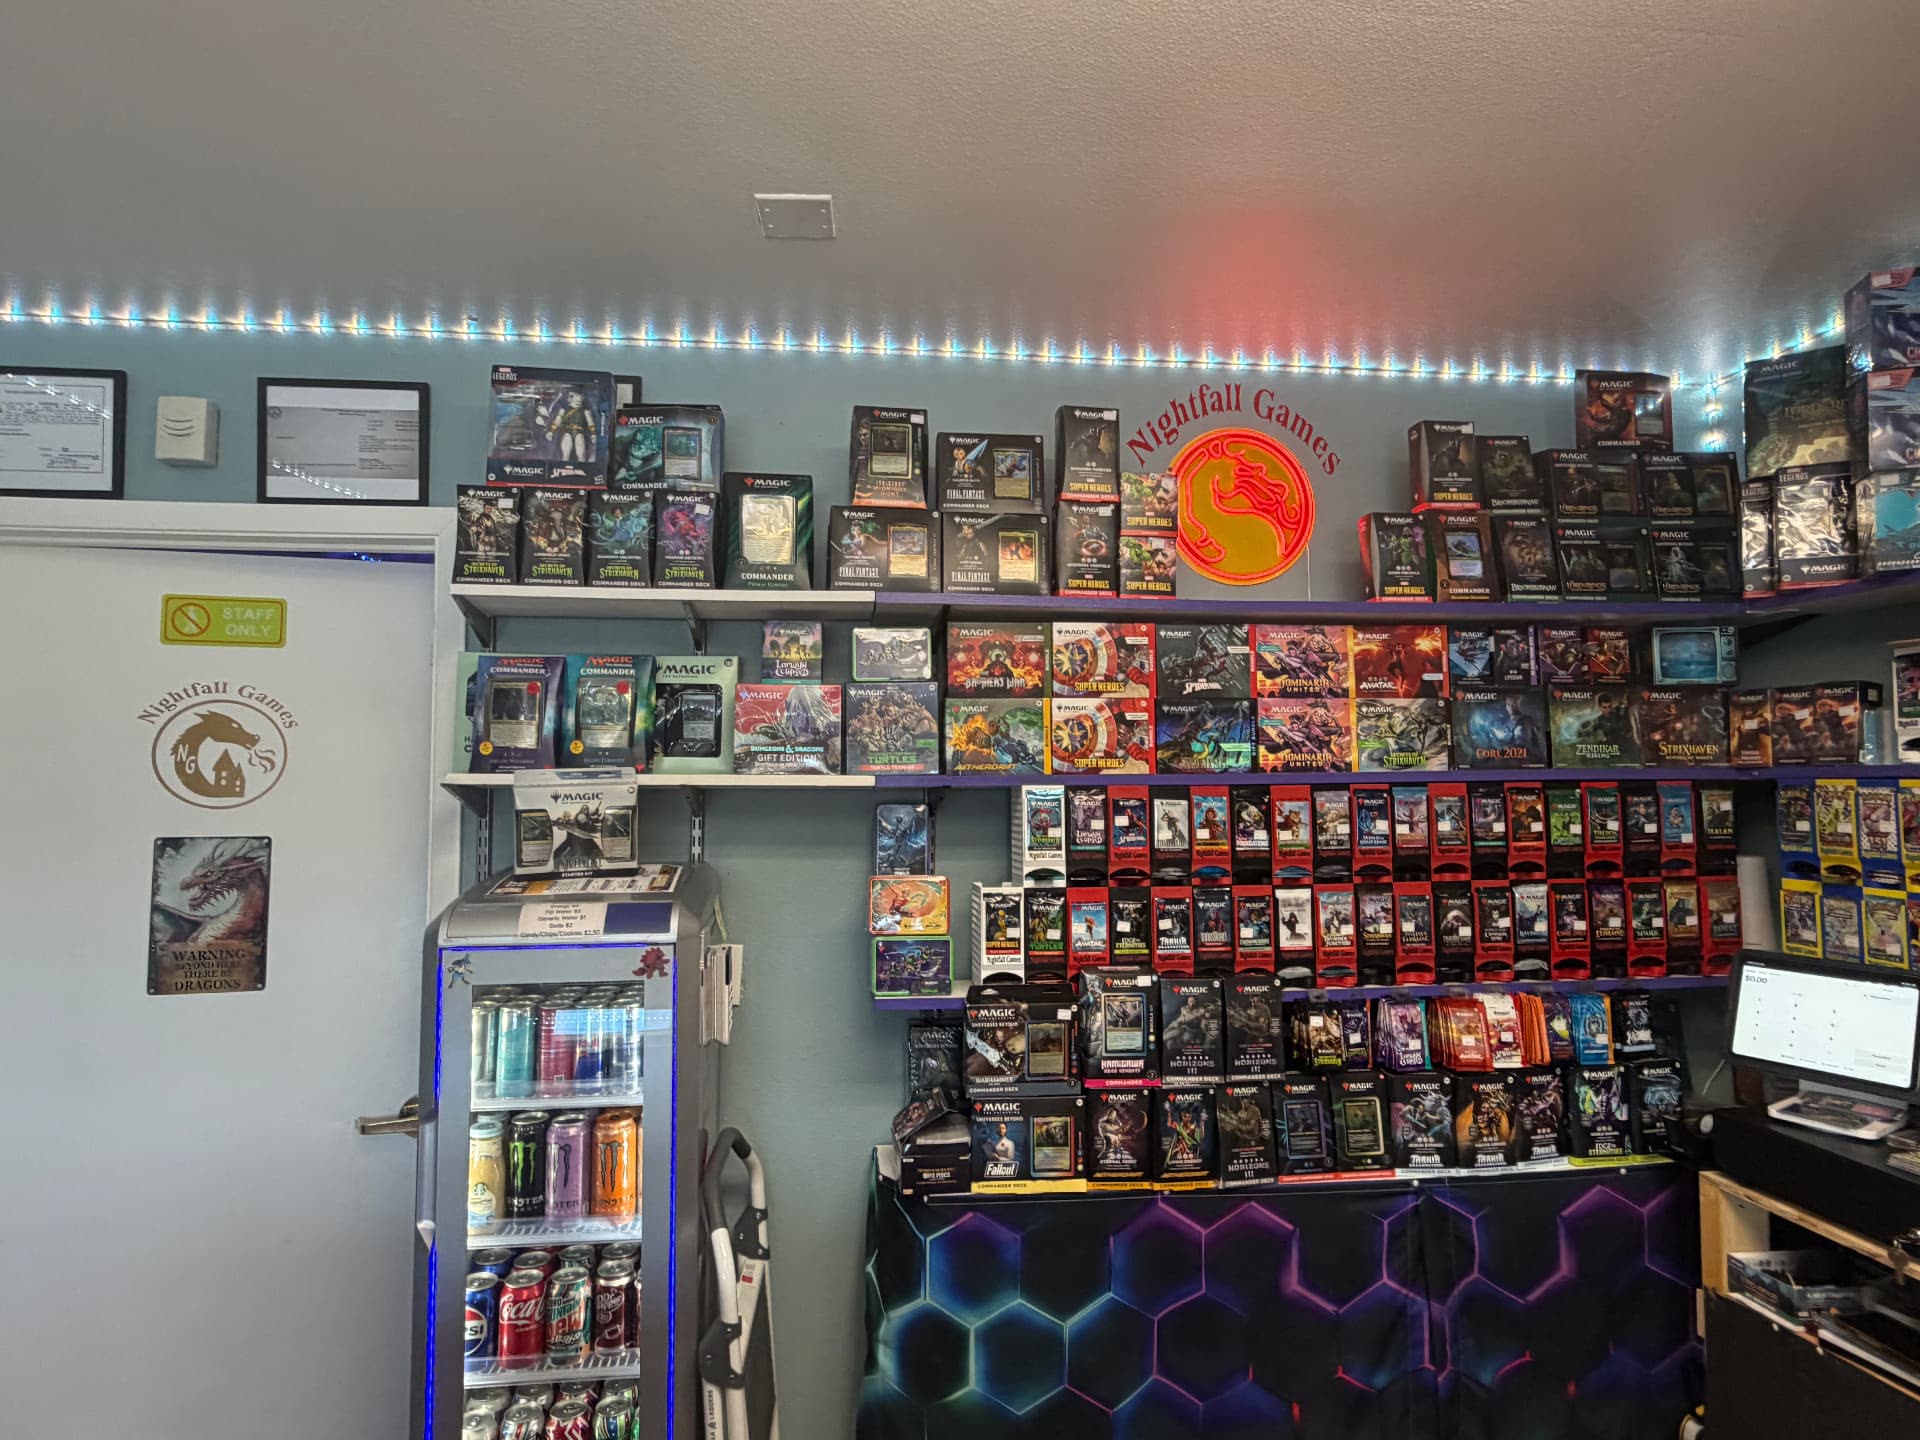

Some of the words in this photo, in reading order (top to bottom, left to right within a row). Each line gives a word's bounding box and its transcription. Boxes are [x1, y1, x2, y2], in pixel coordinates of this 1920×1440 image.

[628, 416, 663, 425] MAGIC
[1126, 383, 1241, 468] Nightfall
[1254, 388, 1341, 476] Games
[512, 466, 543, 475] MAGIC
[1779, 471, 1809, 482] LEGENDS
[475, 490, 506, 498] MAGIC
[542, 491, 573, 499] MAGIC
[608, 494, 639, 502] MAGIC
[1127, 517, 1149, 526] SUPER
[1150, 517, 1173, 527] HEROES
[1810, 563, 1848, 572] MAGIC
[741, 573, 794, 581] COMMANDER
[1126, 581, 1148, 590] SUPER
[1150, 581, 1171, 591] HEROES
[223, 608, 274, 620] STAFF
[225, 624, 272, 637] ONLY
[585, 656, 632, 666] MAGIC
[490, 666, 546, 675] COMMANDER
[663, 665, 716, 673] MAGIC
[1075, 682, 1097, 691] SUPER
[1098, 682, 1125, 692] HEROES
[1282, 679, 1330, 688] DOMINARIA
[1360, 681, 1396, 689] AVATAR
[750, 691, 783, 699] MAGIC
[137, 682, 228, 724] Nightfall
[238, 685, 298, 729] Games
[960, 705, 988, 713] MAGIC
[1576, 744, 1620, 755] ZENDIKAR
[1659, 742, 1719, 755] STRIXHAVEN
[757, 754, 779, 762] GIFT
[780, 754, 817, 762] EDITION
[1282, 753, 1332, 762] DOMINARIA
[1476, 748, 1501, 759] CORE
[1503, 748, 1527, 759] 2021
[1074, 759, 1096, 768] SUPER
[1097, 759, 1124, 768] HEROES
[172, 950, 246, 961] WARNING
[1745, 975, 1767, 984] $0.00
[175, 979, 241, 991] DRAGONS
[978, 1008, 1015, 1017] MAGIC
[922, 1031, 954, 1040] MAGIC
[1532, 1075, 1553, 1083] MAGIC
[984, 1102, 1020, 1111] MAGIC
[1410, 1155, 1441, 1163] TARKIR
[987, 1164, 1016, 1176] Fallout
[1228, 1163, 1269, 1171] HORIZONS
